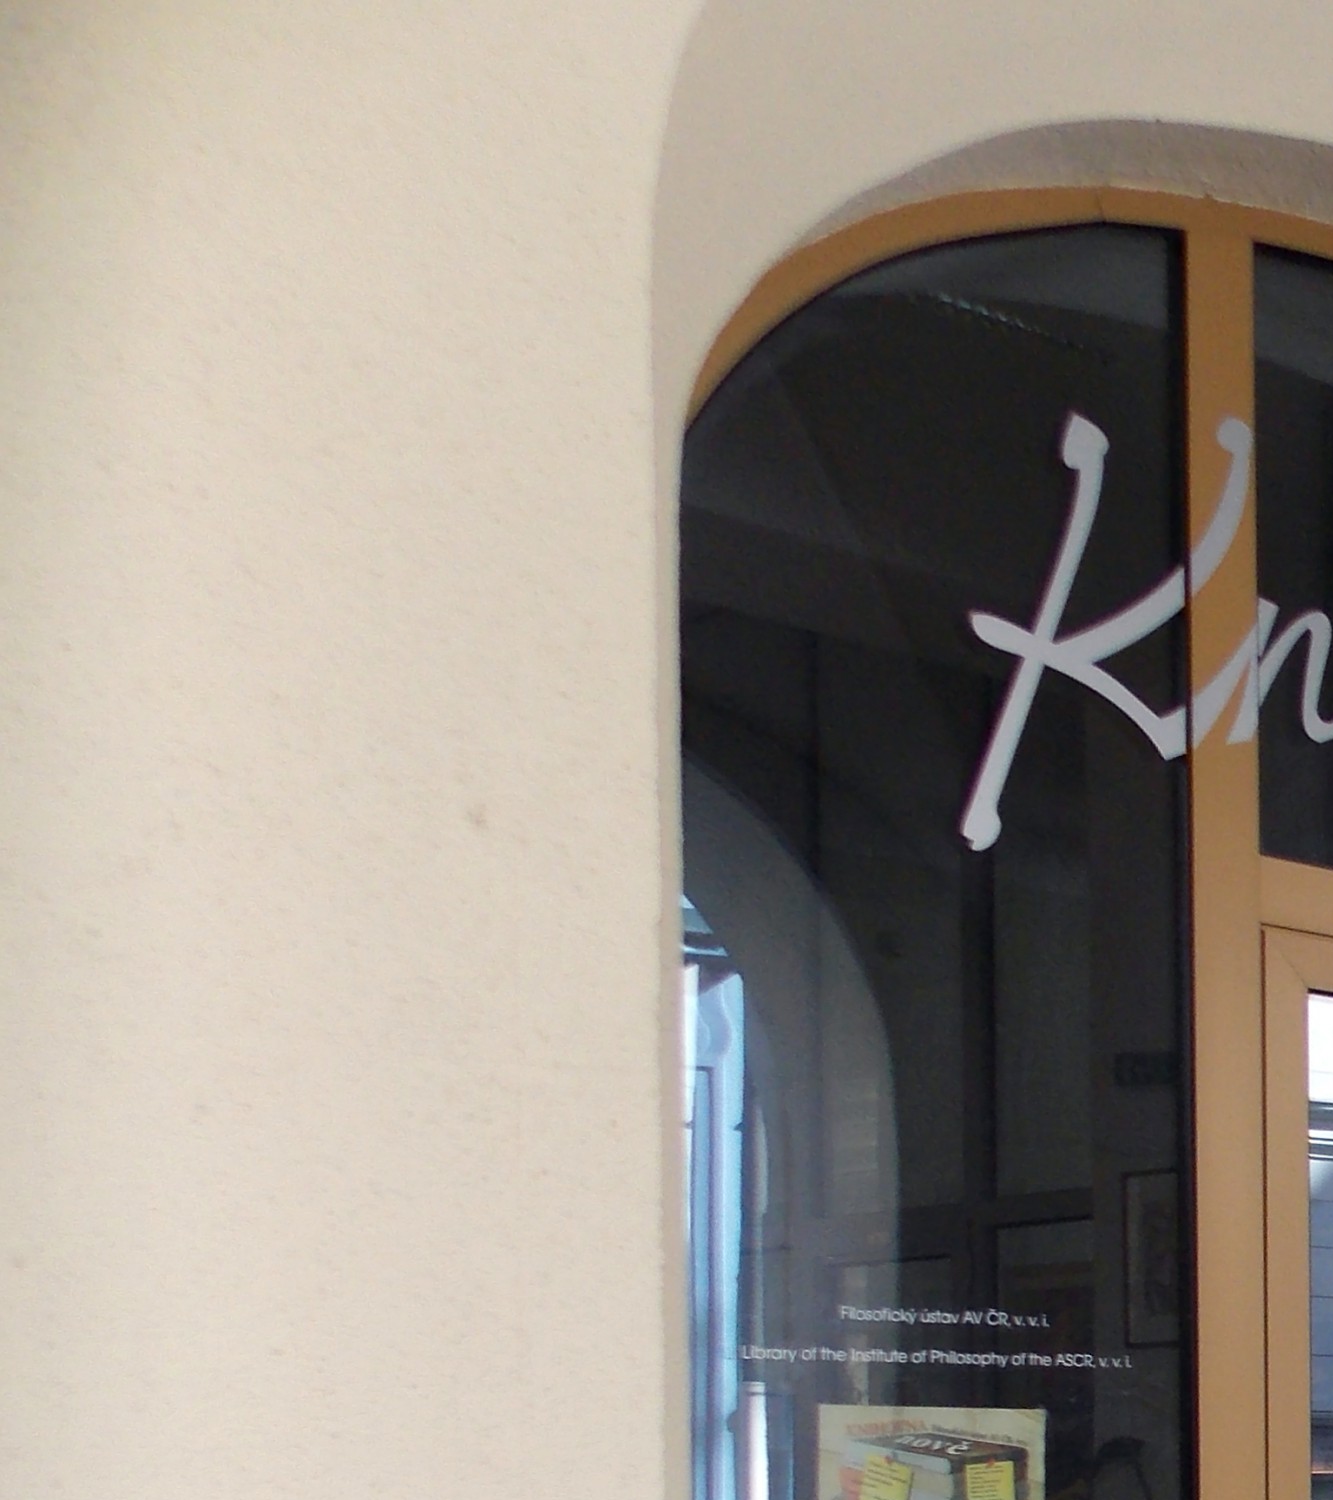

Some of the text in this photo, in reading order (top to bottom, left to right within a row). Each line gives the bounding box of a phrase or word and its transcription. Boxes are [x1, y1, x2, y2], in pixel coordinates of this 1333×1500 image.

[840, 1305, 917, 1325] Filosofický
[920, 1308, 960, 1324] ústav
[962, 1310, 983, 1325] AV
[741, 1345, 797, 1363] Library
[801, 1346, 817, 1361] of
[821, 1346, 848, 1362] the
[851, 1348, 909, 1363] Institute
[911, 1349, 927, 1364] of
[930, 1350, 1009, 1368] Philosophy
[1011, 1352, 1027, 1367] of
[1028, 1352, 1052, 1367] the
